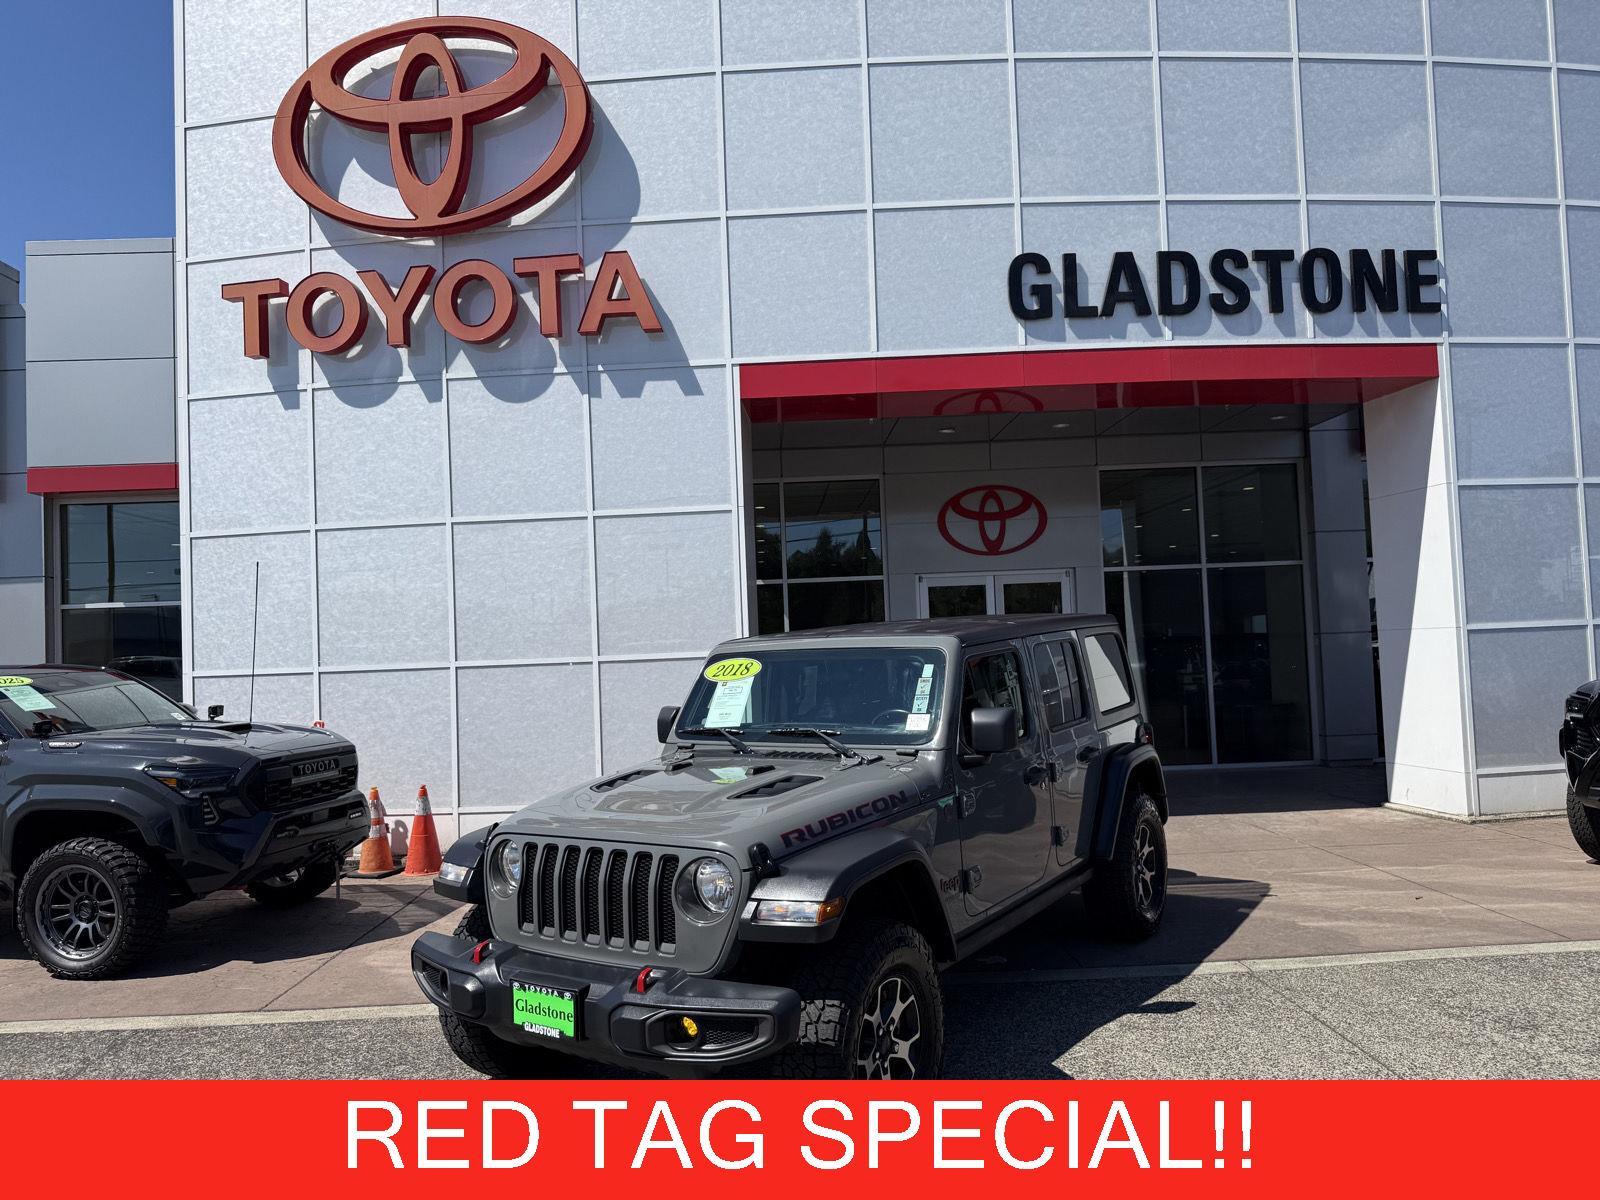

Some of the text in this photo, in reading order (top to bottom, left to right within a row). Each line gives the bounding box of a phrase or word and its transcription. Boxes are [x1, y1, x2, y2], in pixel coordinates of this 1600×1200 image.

[1007, 247, 1442, 321] GLADSTONE
[221, 250, 664, 360] TOYOTA
[712, 662, 754, 678] 2018
[0, 677, 25, 685] 025
[298, 759, 336, 775] TOYOTA
[779, 790, 909, 849] RUBICON
[524, 984, 560, 997] TOYOTA
[515, 998, 574, 1023] Gladstone
[523, 1021, 561, 1039] GLADSTONE
